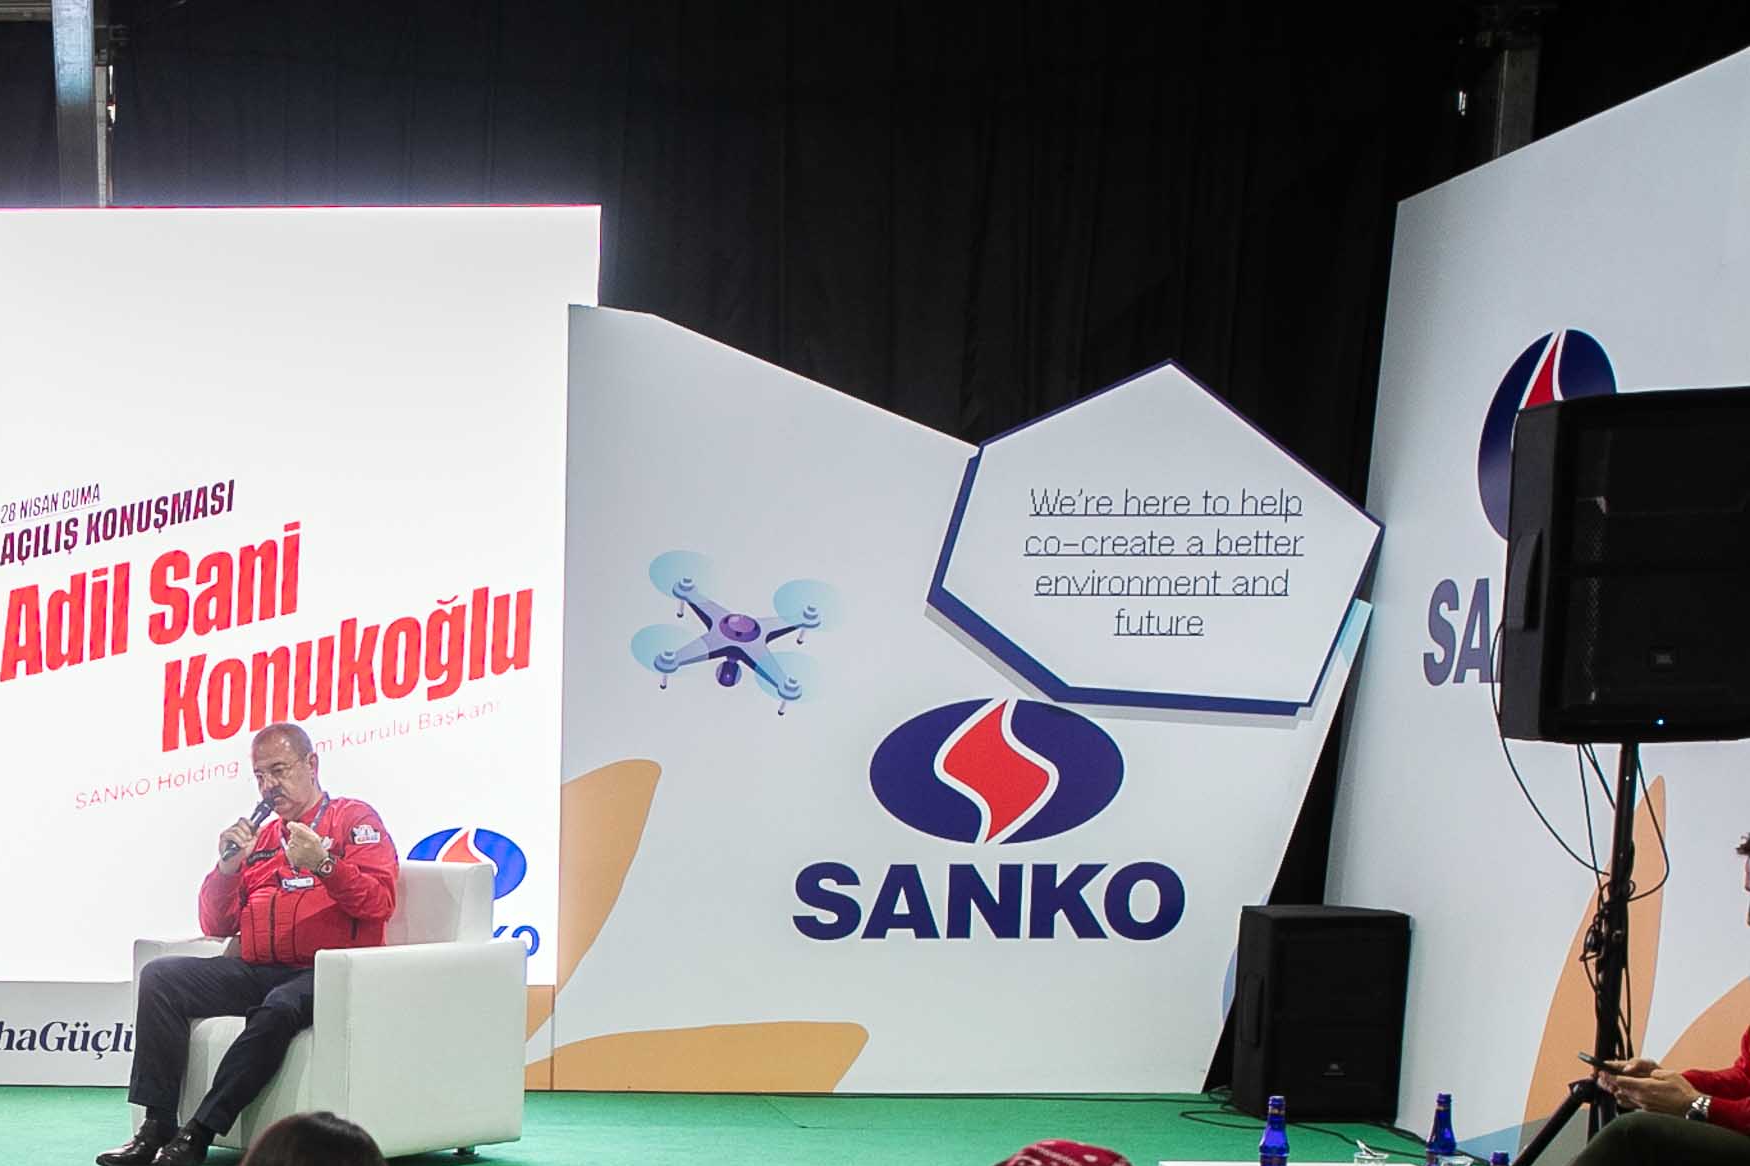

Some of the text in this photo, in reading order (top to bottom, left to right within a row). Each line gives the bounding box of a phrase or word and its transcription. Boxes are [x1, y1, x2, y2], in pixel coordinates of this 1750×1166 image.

[0, 502, 16, 524] 28
[62, 483, 100, 510] CUMA
[1030, 488, 1302, 523] We're here to help
[0, 479, 234, 566] AÇILIŞ KONUŞMASI
[1025, 529, 1304, 556] co-create a better
[1035, 568, 1289, 596] environment and
[0, 521, 301, 682] Adil Sani
[1115, 608, 1203, 636] future
[161, 586, 534, 752] Konukoğlu
[341, 719, 411, 748] Kurulu
[75, 778, 150, 810] SANKO
[792, 861, 1186, 941] SANKO
